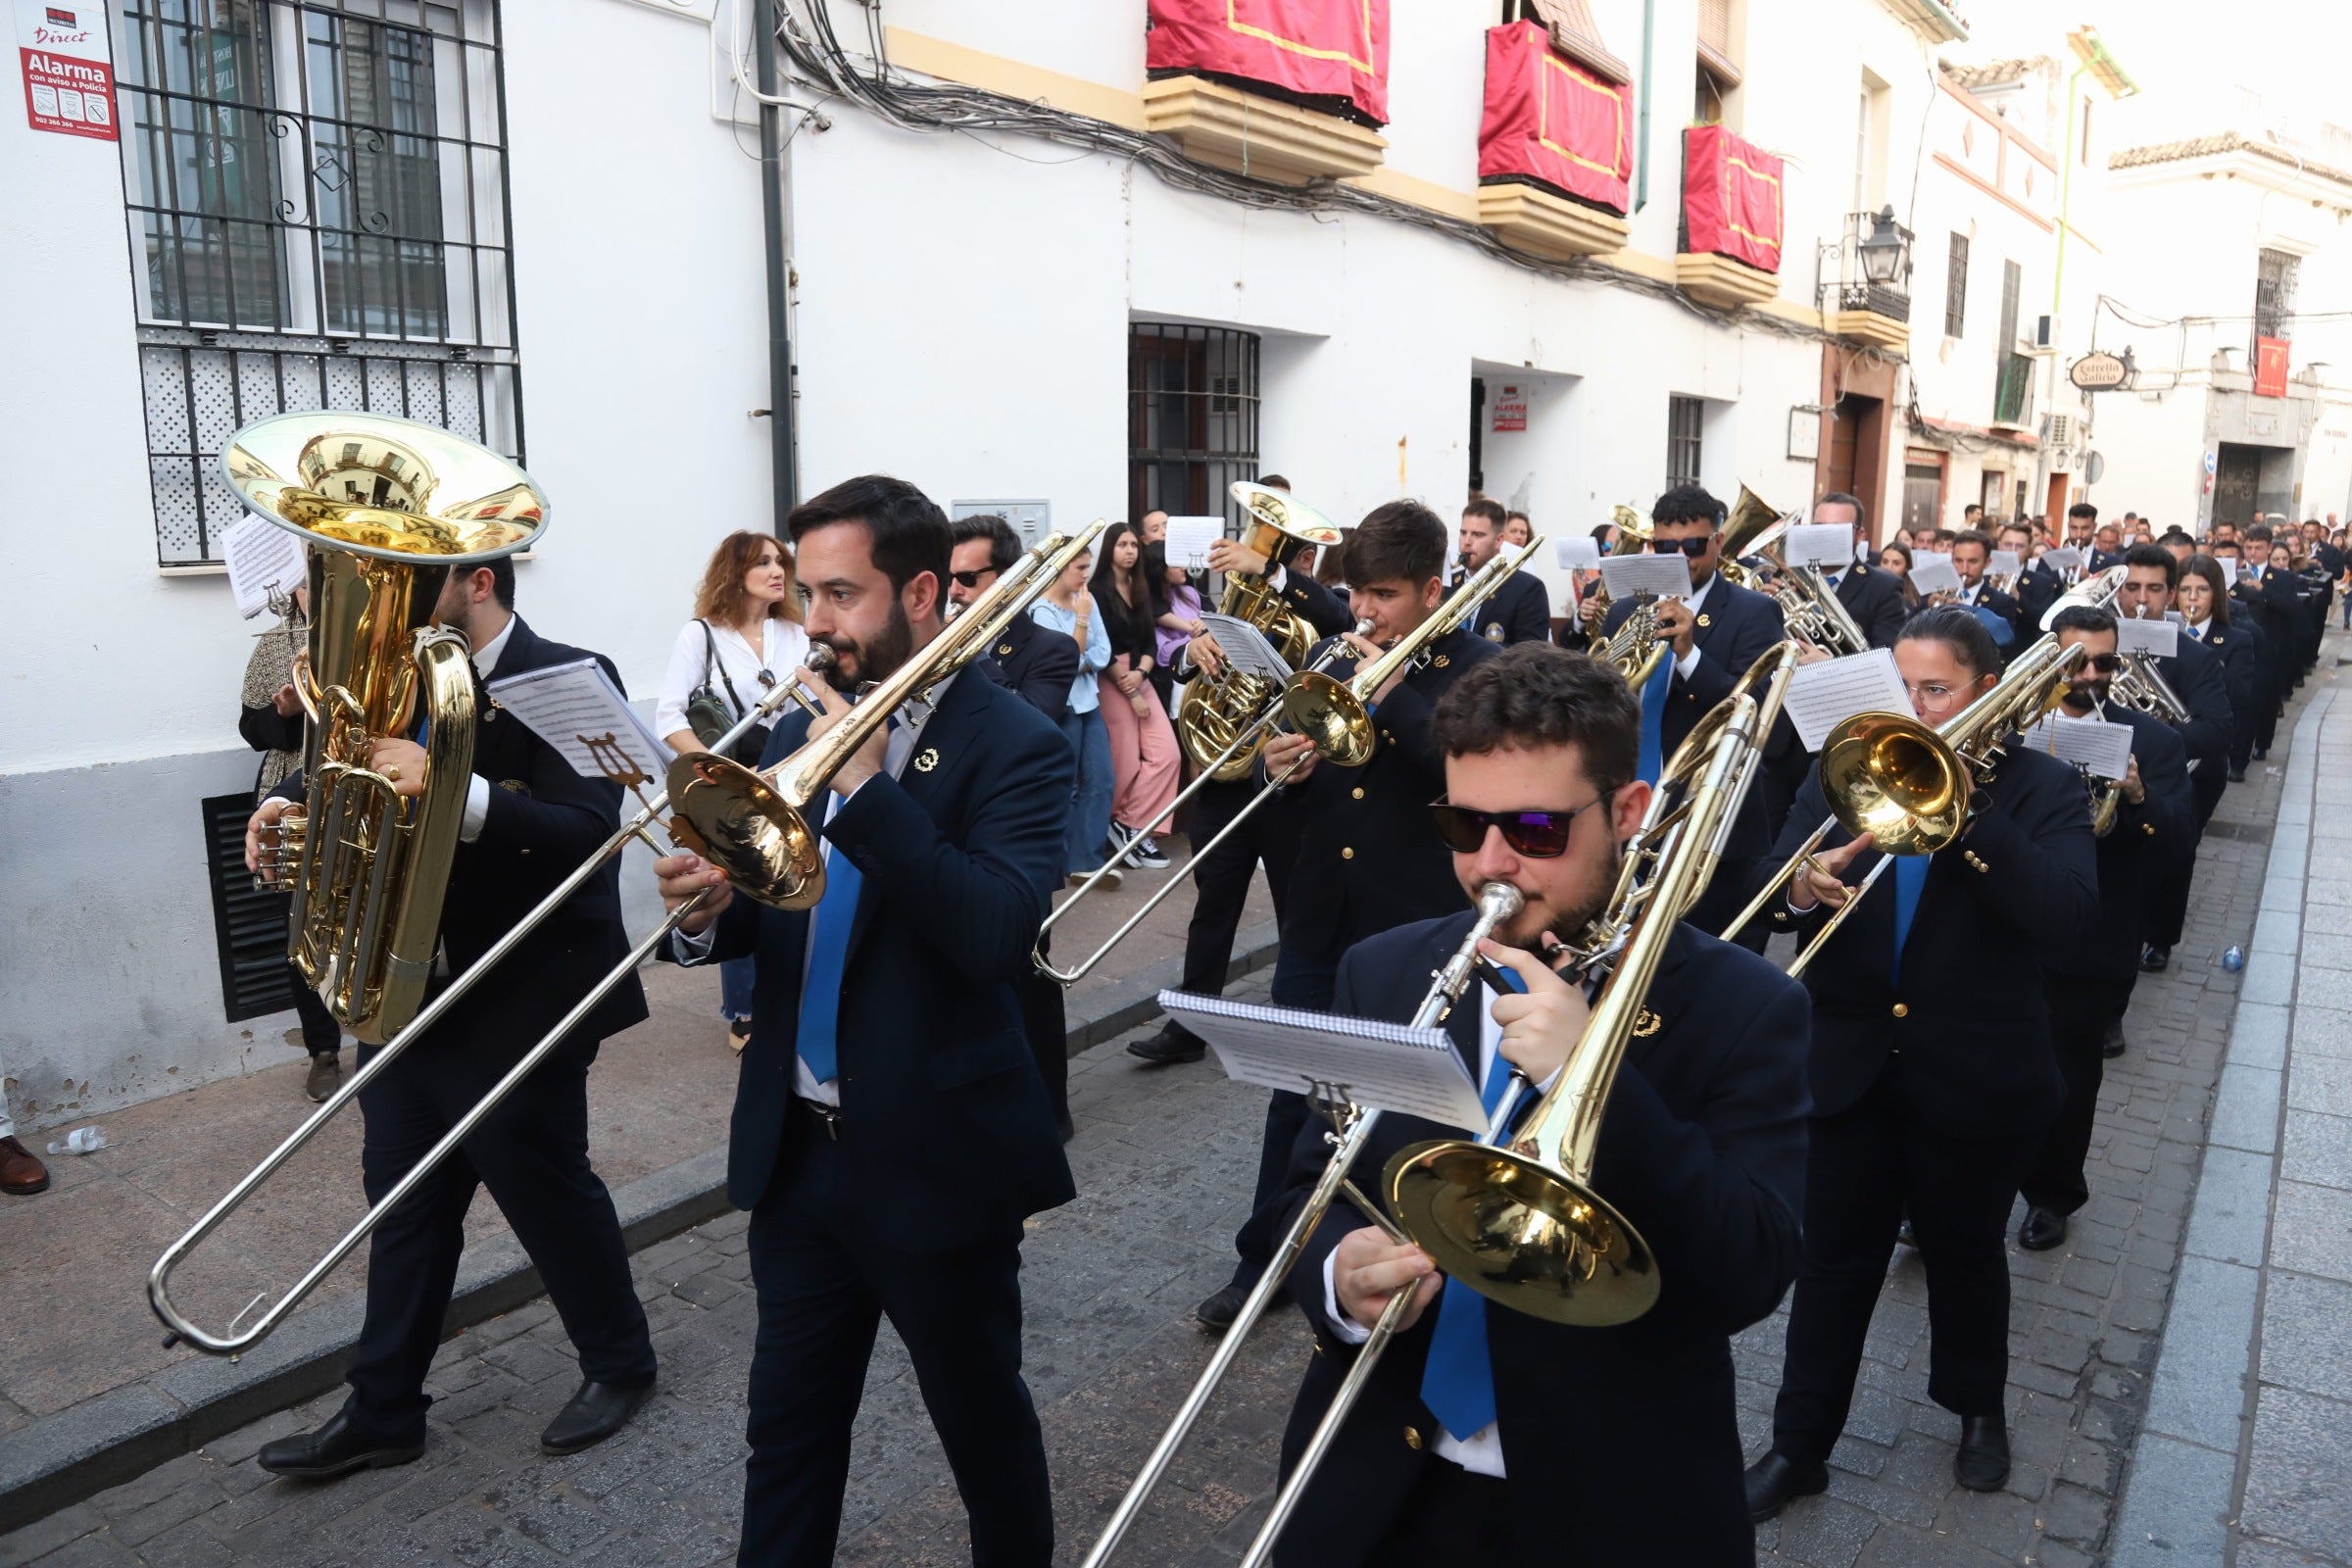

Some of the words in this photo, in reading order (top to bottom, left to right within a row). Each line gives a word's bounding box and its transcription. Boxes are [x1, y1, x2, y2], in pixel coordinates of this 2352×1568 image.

[33, 27, 93, 44] Direct
[28, 54, 106, 83] Alarma
[47, 77, 71, 87] aviso
[34, 116, 47, 124] 902
[2080, 363, 2119, 372] Estrella
[2080, 372, 2117, 382] Galicia
